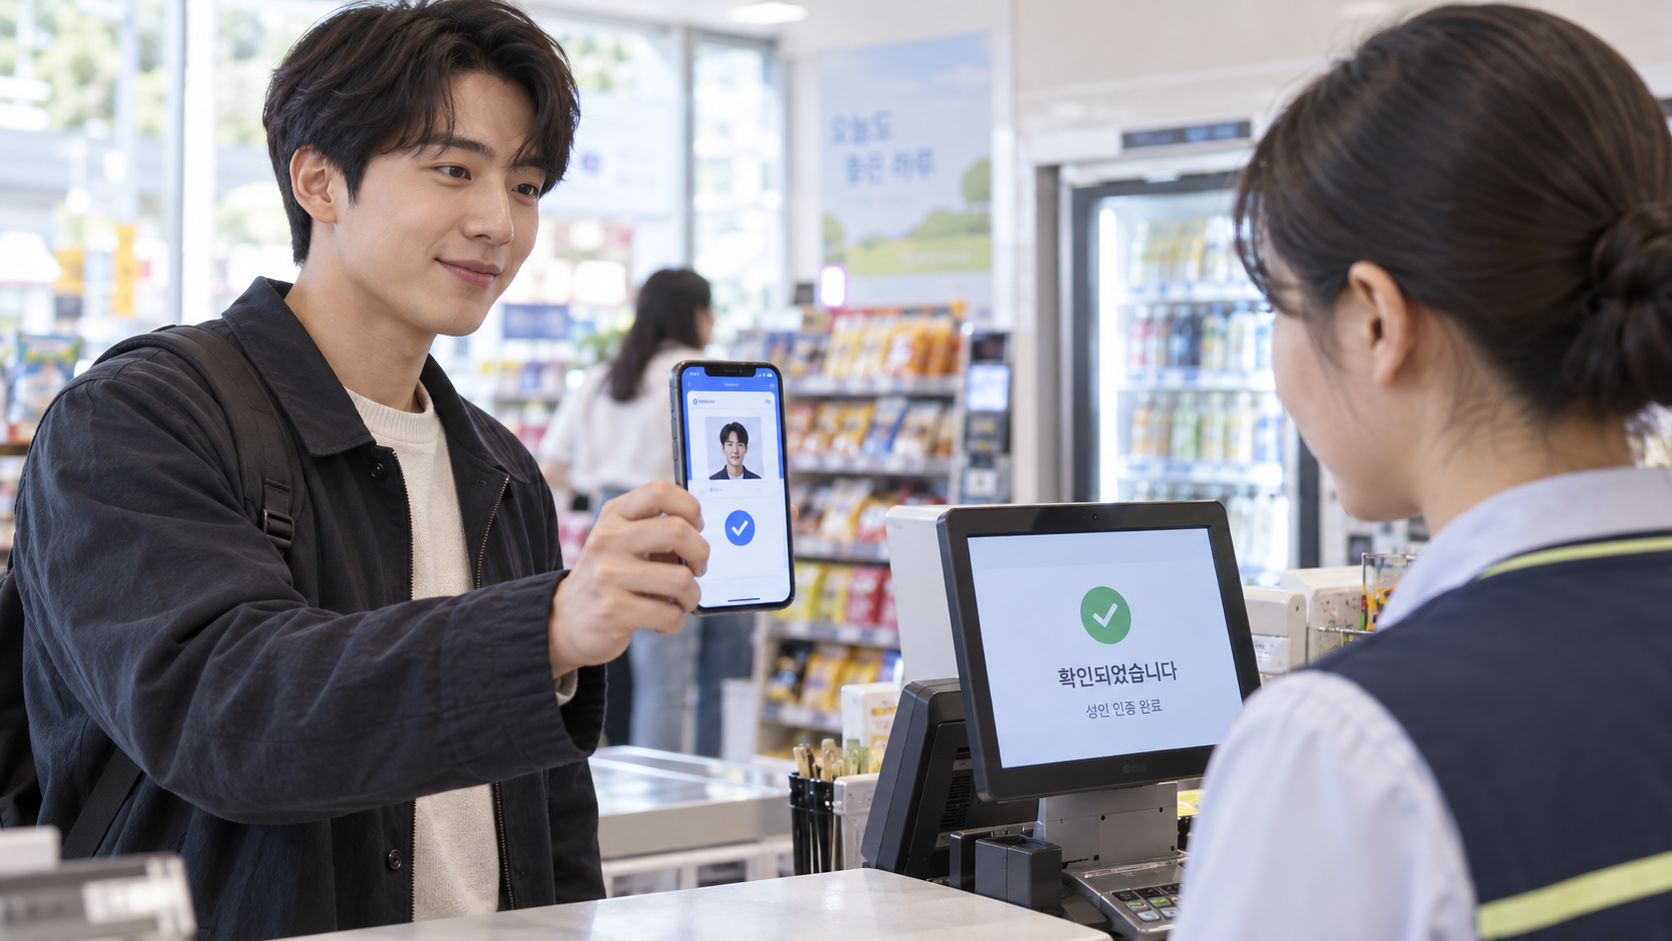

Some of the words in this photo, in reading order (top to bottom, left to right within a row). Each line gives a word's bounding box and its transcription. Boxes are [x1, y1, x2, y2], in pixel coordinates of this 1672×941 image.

[829, 112, 894, 144] 오늘도
[846, 152, 885, 184] 좋은
[1058, 660, 1178, 688] 확인되었습니다
[1086, 702, 1110, 719] 성인
[1112, 701, 1136, 717] 인증
[1139, 699, 1163, 715] 완료
